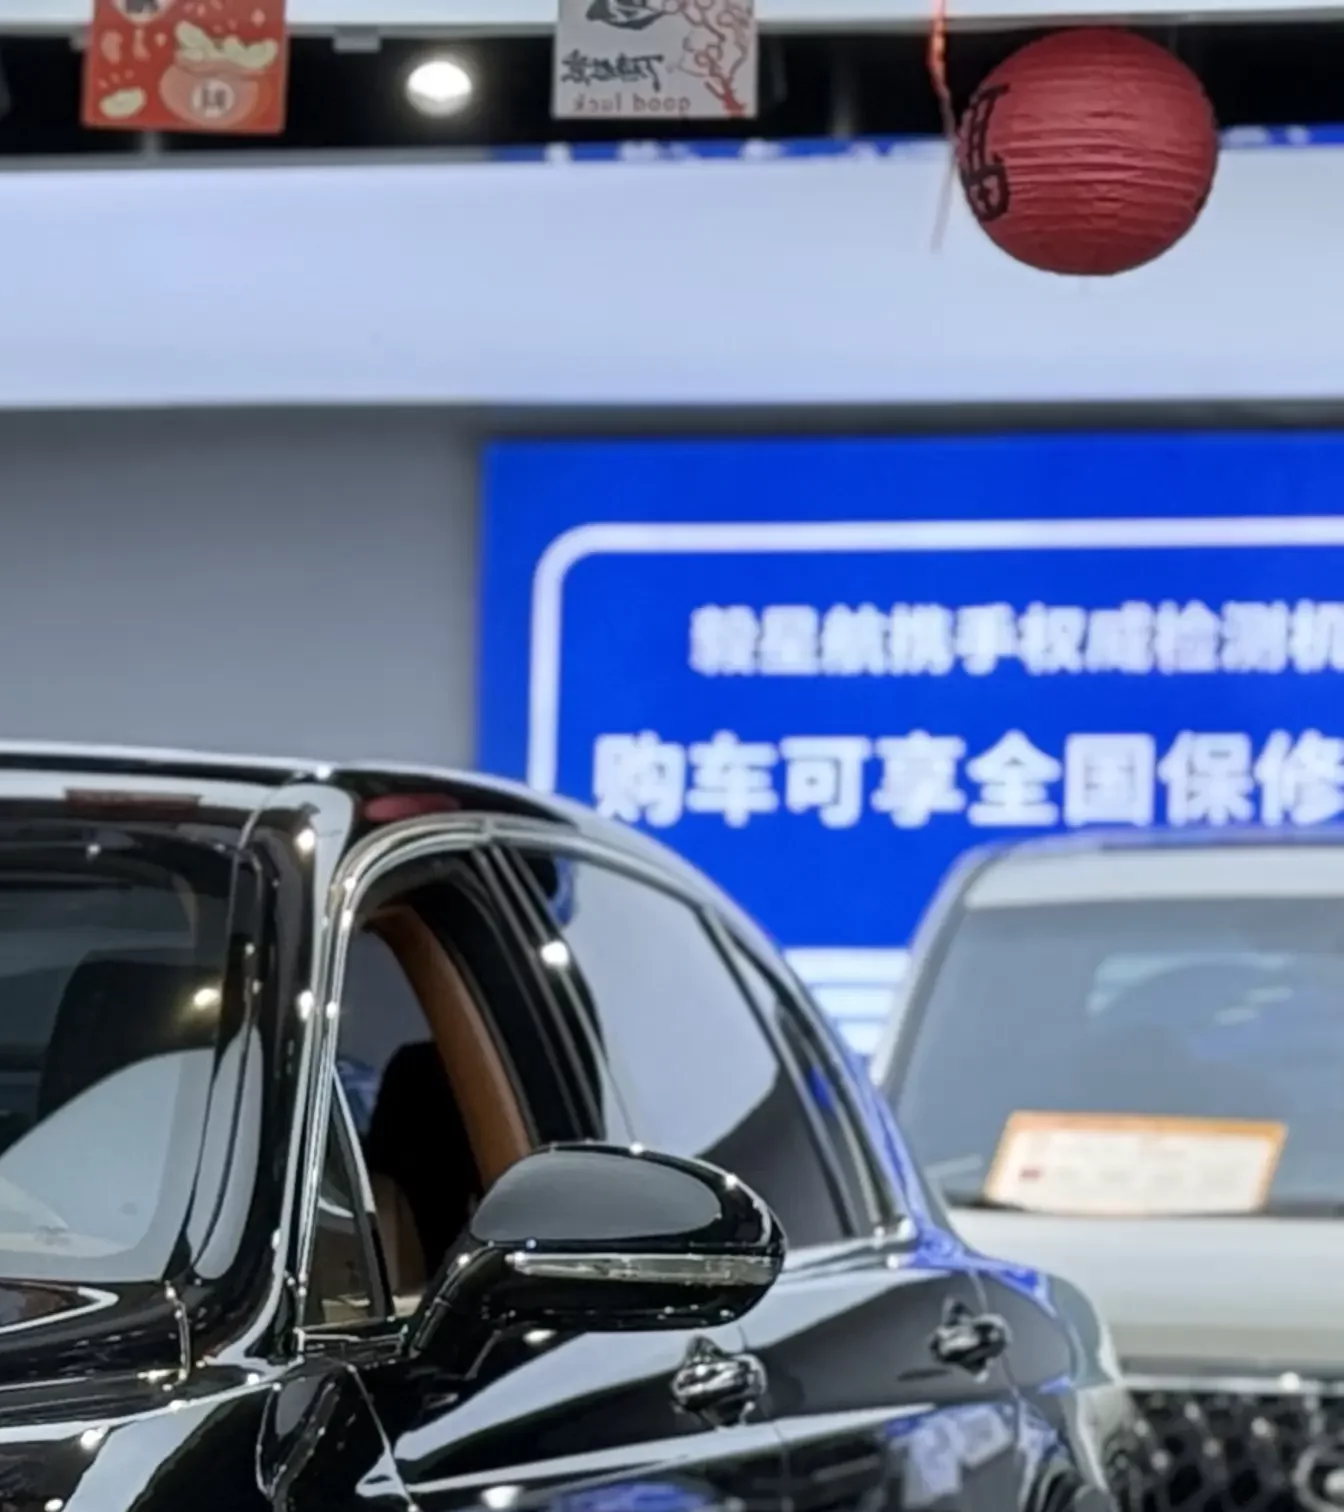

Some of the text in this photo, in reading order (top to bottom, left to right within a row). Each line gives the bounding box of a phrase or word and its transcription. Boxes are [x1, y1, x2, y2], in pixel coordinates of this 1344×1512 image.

[593, 727, 1344, 828] 购车可享全国保修
